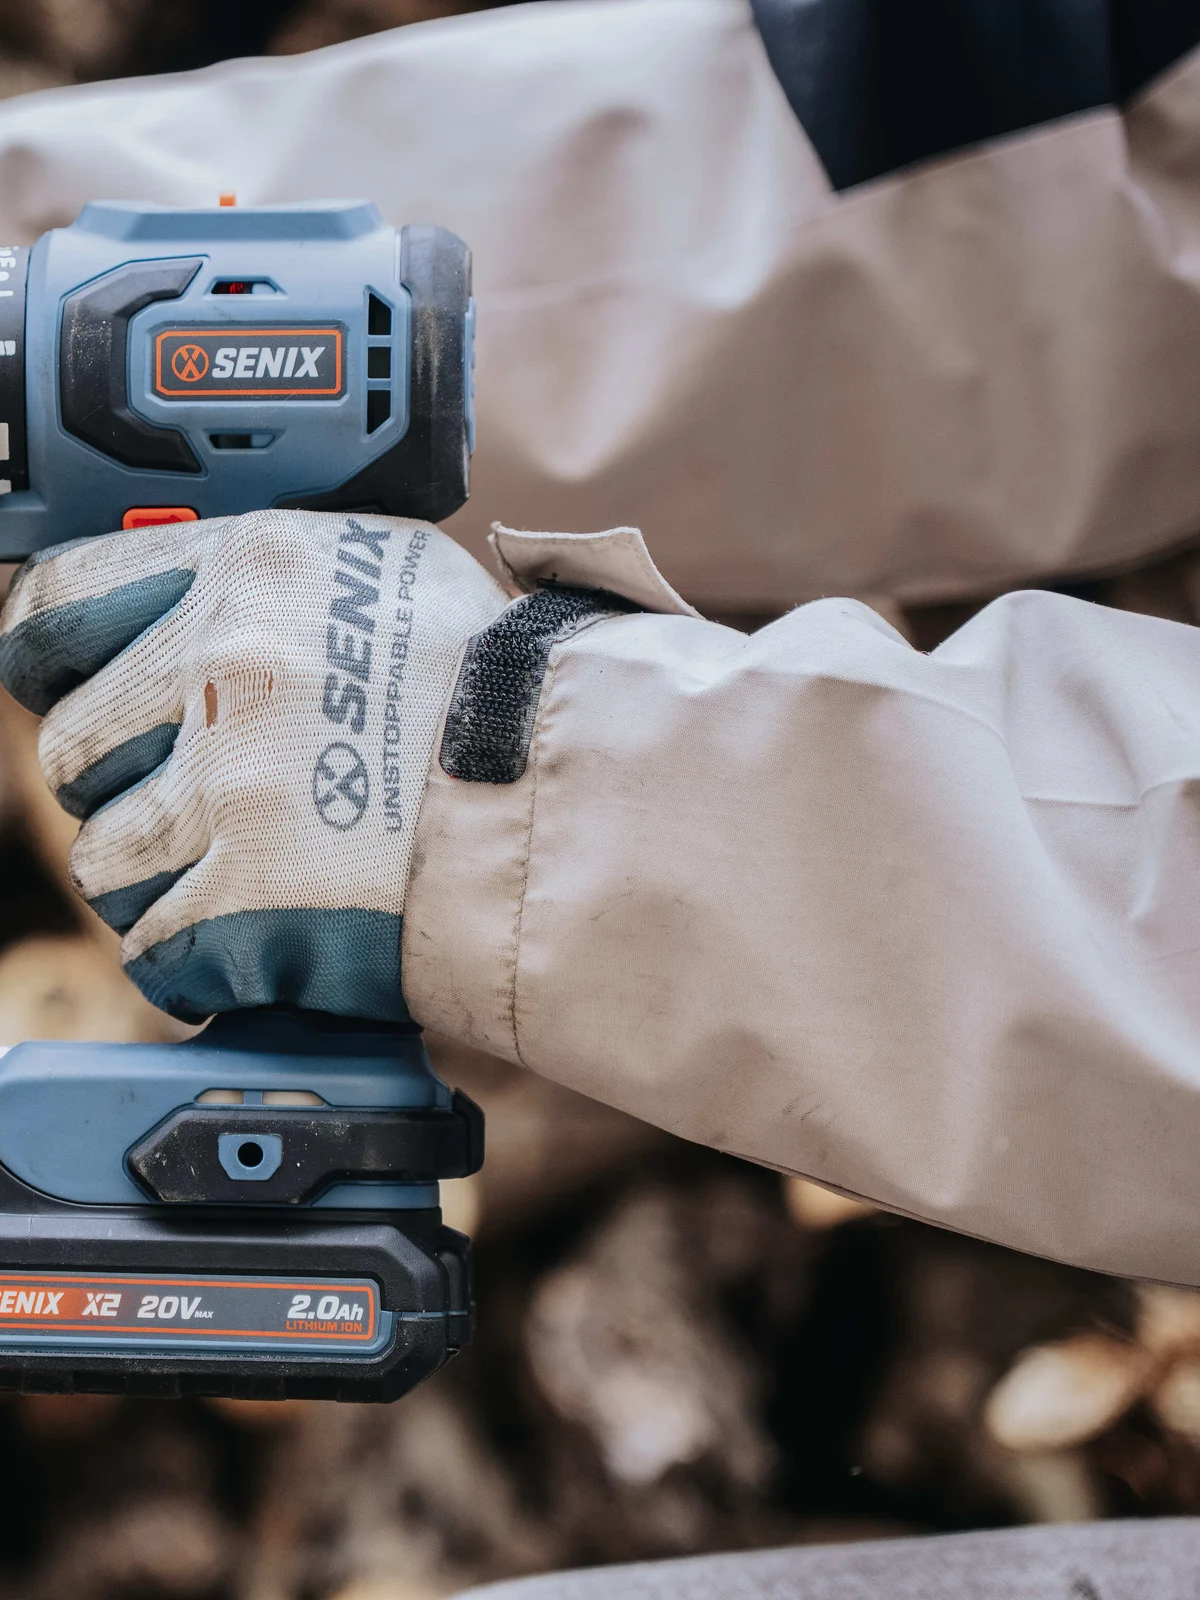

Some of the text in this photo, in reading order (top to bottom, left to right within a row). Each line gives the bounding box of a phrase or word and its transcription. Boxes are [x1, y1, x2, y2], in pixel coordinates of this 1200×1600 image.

[211, 347, 326, 379] SENIX
[322, 519, 391, 733] SENIX
[382, 529, 432, 832] UNSTOPPABLE POWER
[81, 1293, 122, 1317] X2
[287, 1294, 364, 1321] 2.0Ah
[285, 1320, 363, 1333] LITHIUM ION
